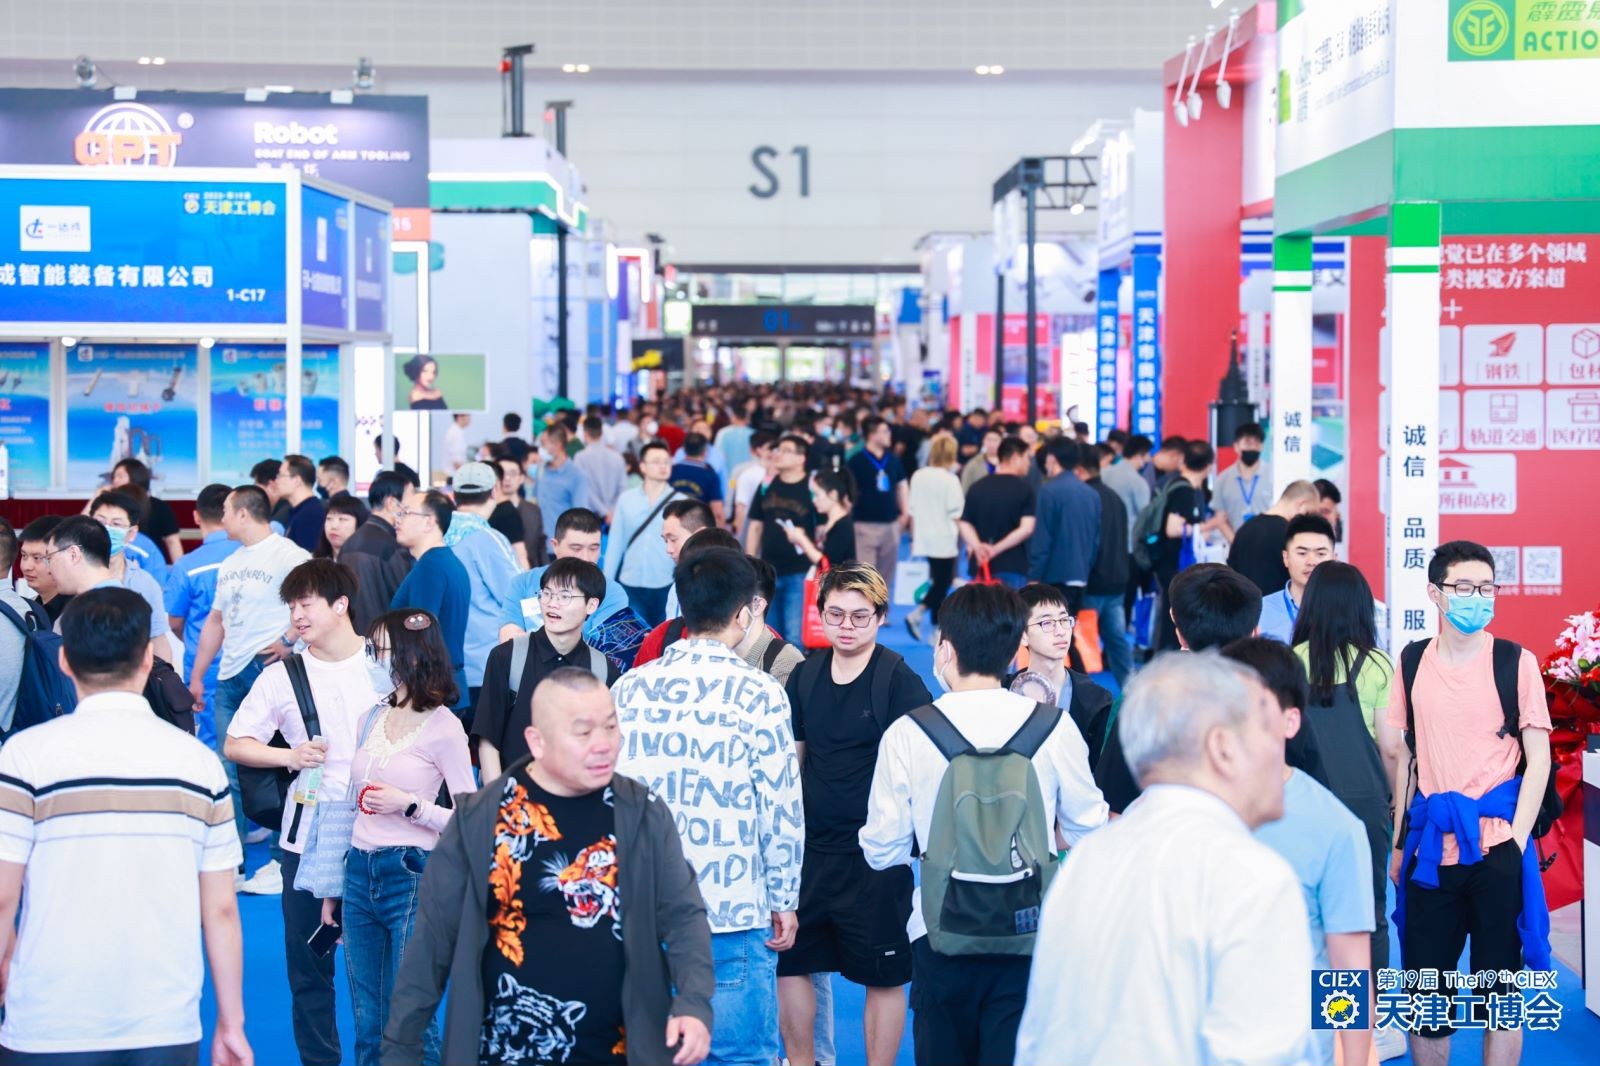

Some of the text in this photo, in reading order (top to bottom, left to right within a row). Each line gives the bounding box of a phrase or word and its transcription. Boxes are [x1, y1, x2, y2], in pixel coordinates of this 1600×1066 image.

[254, 121, 339, 145] Robot
[286, 149, 311, 160] END
[313, 150, 329, 160] OF
[331, 150, 358, 161] ARM
[361, 151, 411, 162] TOOLING
[748, 145, 810, 199] S1
[1440, 242, 1588, 264] 觉已在多个领域
[1440, 267, 1566, 290] 类视觉方案超
[226, 288, 267, 303] 1-C17
[1485, 363, 1520, 380] 钢铁
[1284, 411, 1302, 453] 诚信
[1471, 427, 1537, 446] 轨道交通
[1403, 425, 1427, 646] 诚信 品质 服
